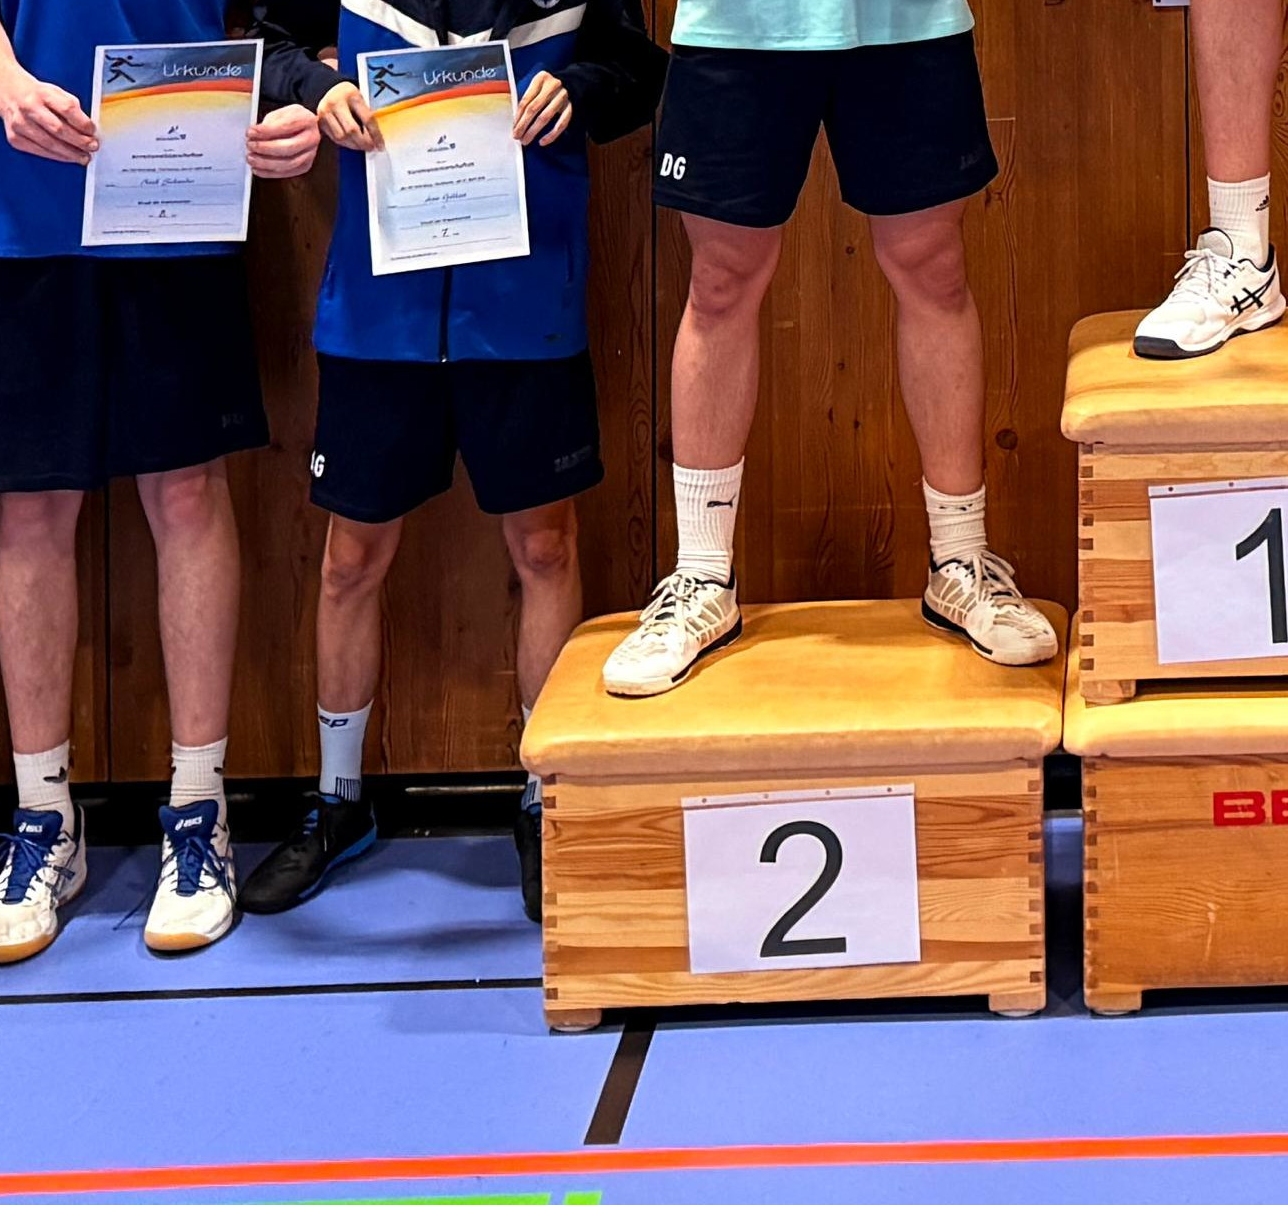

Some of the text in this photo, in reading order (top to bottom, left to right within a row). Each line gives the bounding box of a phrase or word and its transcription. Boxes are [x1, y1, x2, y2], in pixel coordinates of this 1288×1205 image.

[163, 63, 242, 77] Urkunde
[423, 65, 497, 86] Urkunde
[659, 152, 686, 180] DG
[1235, 507, 1288, 644] 1
[759, 820, 847, 958] 2
